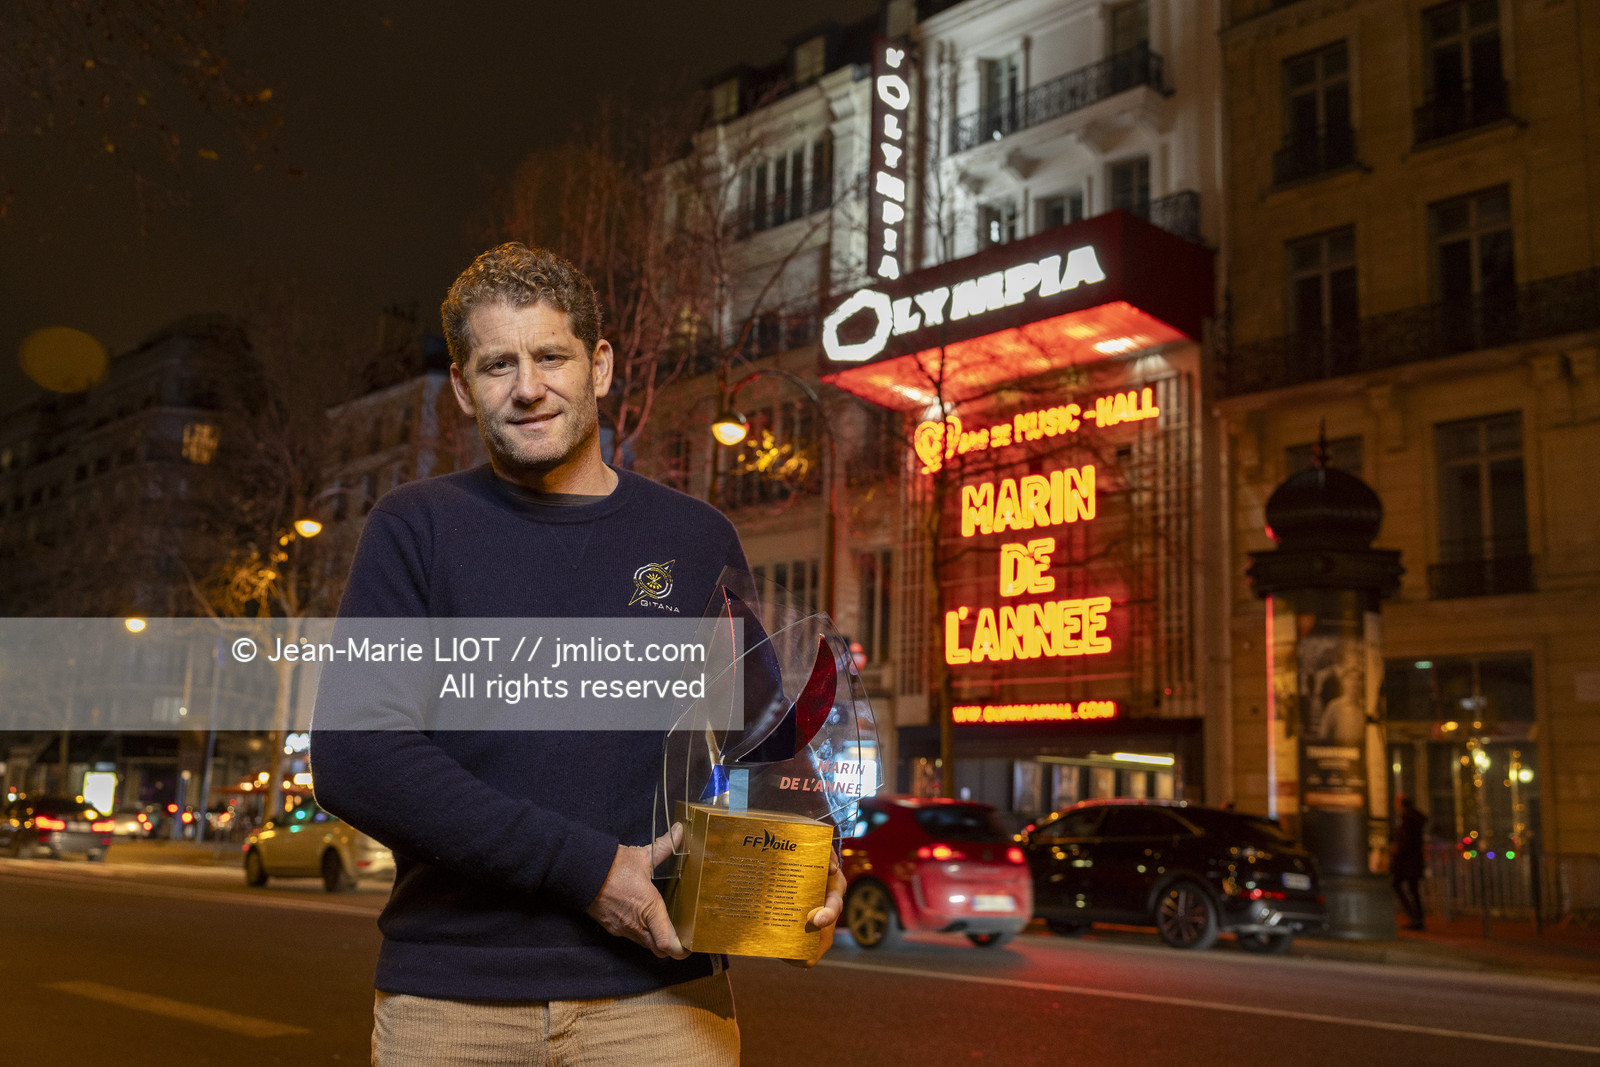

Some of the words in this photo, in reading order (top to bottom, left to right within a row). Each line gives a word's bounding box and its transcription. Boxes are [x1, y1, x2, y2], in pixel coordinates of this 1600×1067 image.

[822, 245, 1106, 362] OLYMPIA
[961, 464, 1096, 538] MARIN
[999, 537, 1056, 597] DE
[640, 599, 680, 613] GITANA
[945, 596, 1112, 665] L'ANNEE
[779, 776, 801, 791] DE
[816, 760, 866, 775] MARIN
